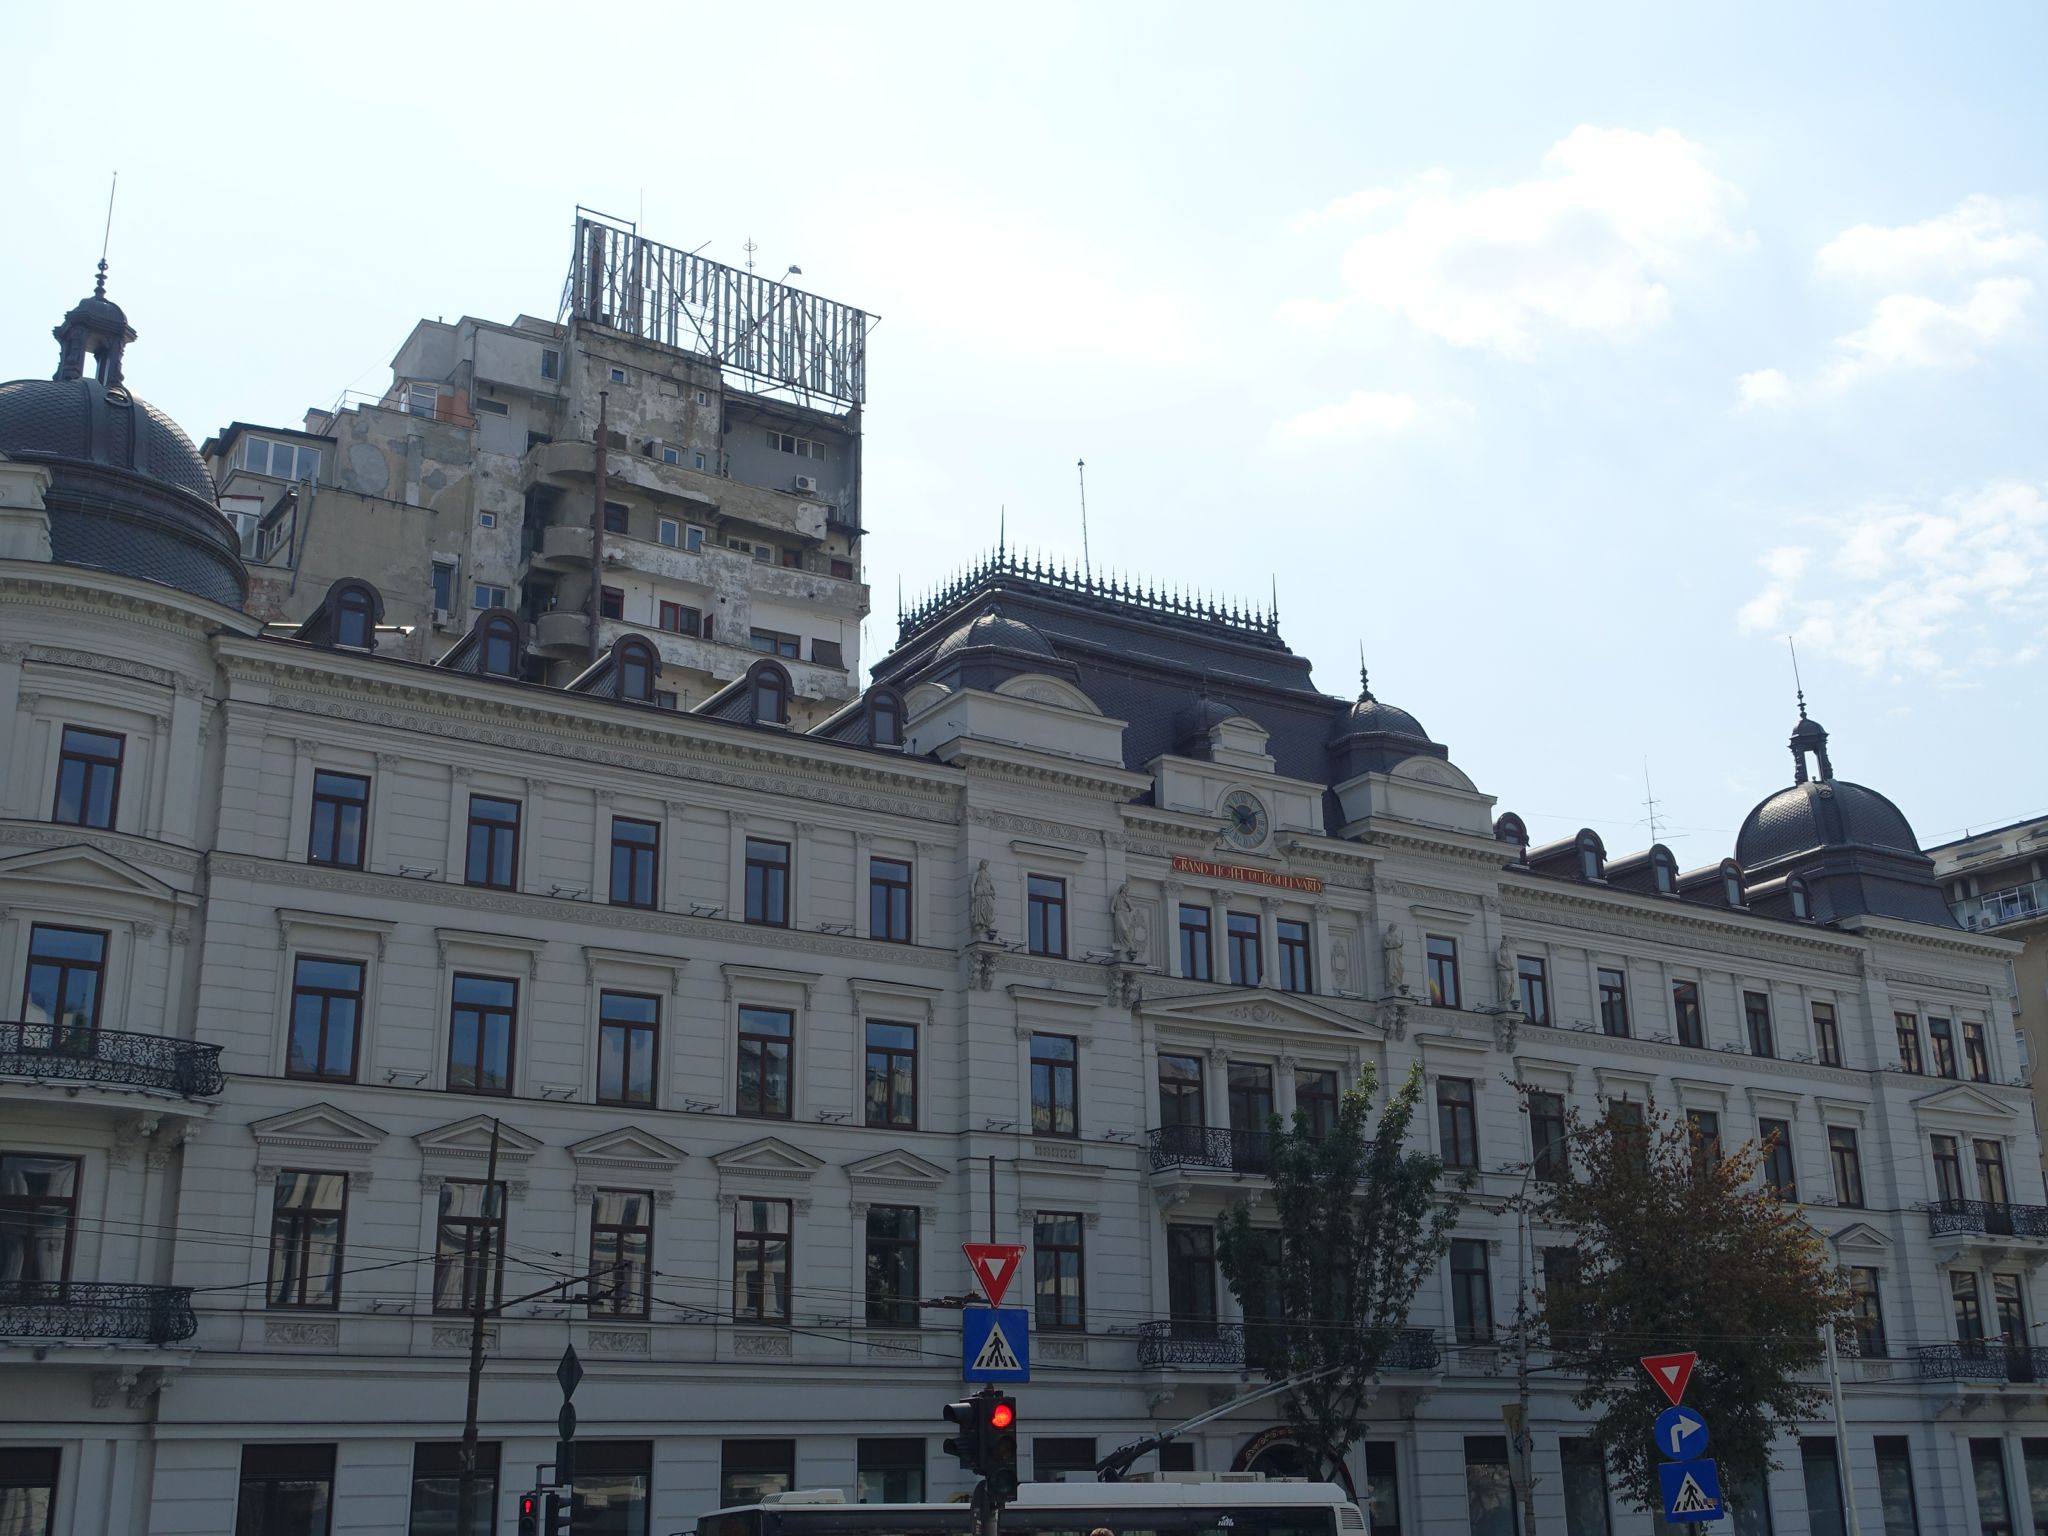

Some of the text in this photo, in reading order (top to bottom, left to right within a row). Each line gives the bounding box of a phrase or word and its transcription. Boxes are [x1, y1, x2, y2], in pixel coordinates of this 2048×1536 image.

[1173, 858, 1321, 891] GRAND HOTEL DU BOULEVARD
